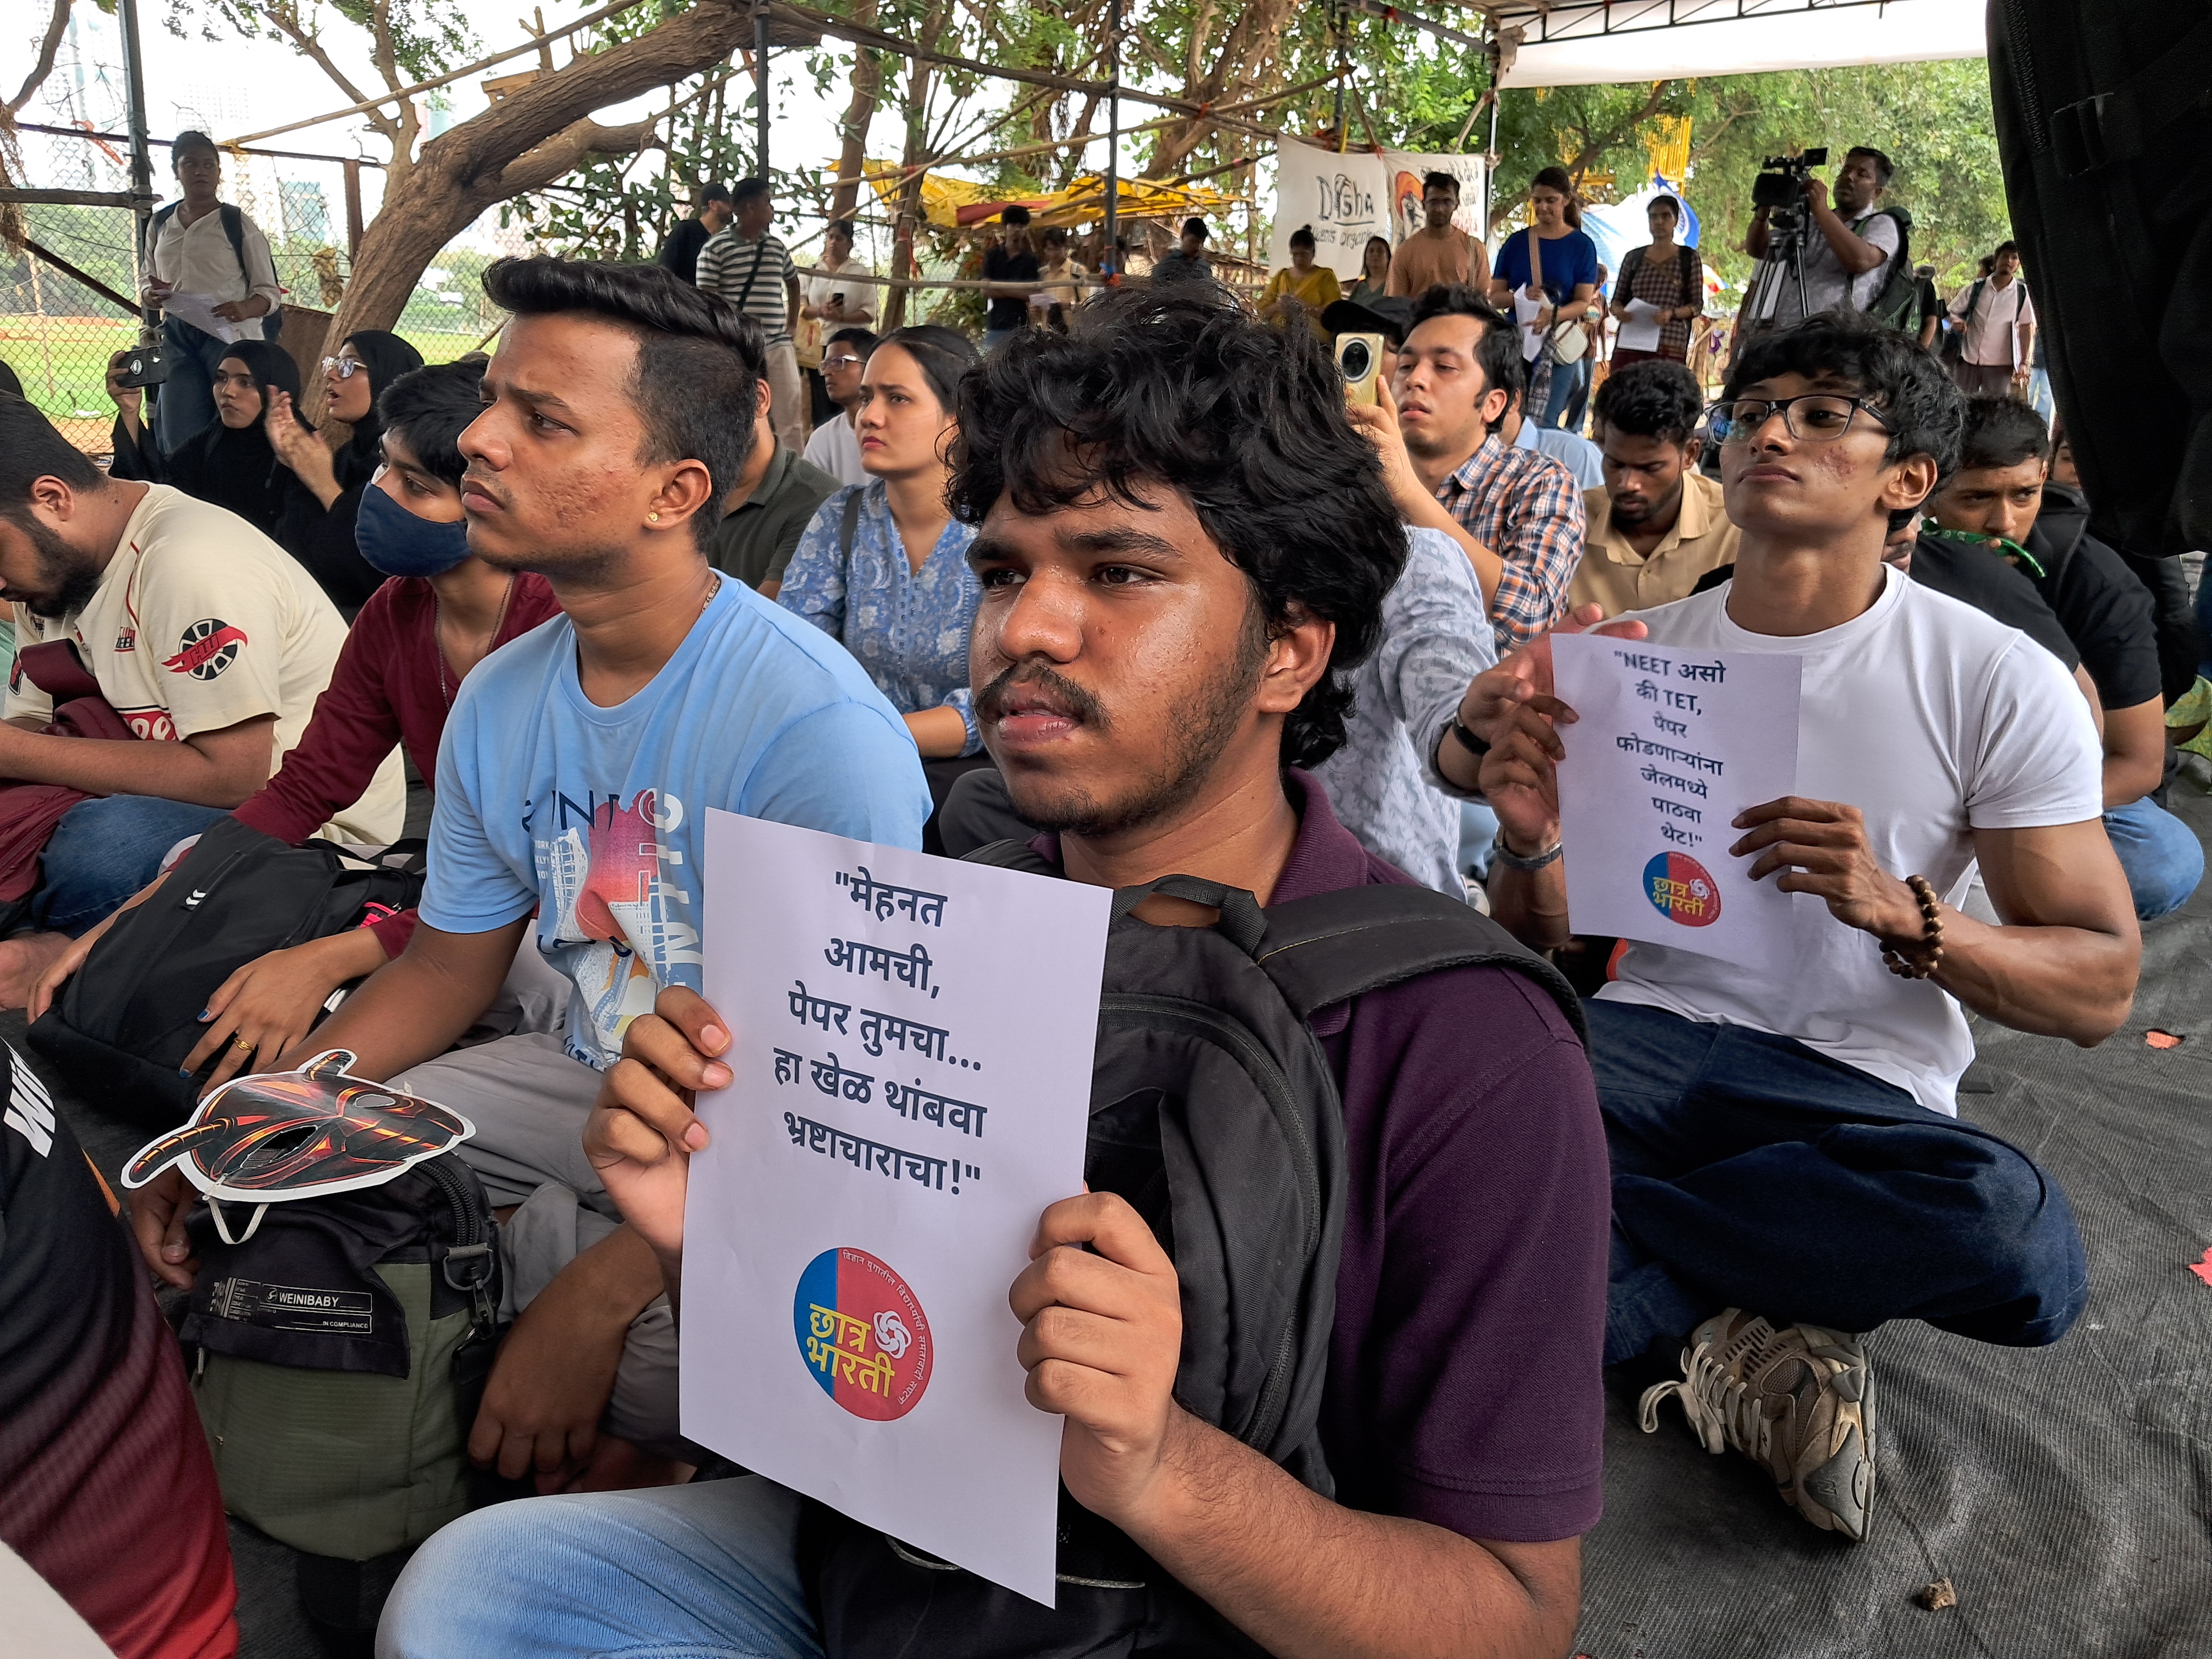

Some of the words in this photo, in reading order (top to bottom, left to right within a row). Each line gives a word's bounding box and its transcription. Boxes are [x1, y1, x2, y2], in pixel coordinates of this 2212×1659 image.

[1615, 650, 1672, 677] "NEET
[1677, 660, 1727, 684] असो
[1635, 679, 1658, 702] की
[1663, 689, 1702, 716] TET,
[1652, 710, 1688, 738] पेपर
[1639, 763, 1708, 800] जेलमध्ये
[1650, 796, 1702, 824] पाठवा
[1660, 821, 1703, 847] थेट!"
[835, 866, 948, 927] "मेहनत
[1652, 877, 1689, 898] छात्र
[1652, 891, 1704, 916] भारती
[824, 938, 940, 999] आमची,
[788, 980, 852, 1036] पेपर
[860, 1008, 981, 1071] तुमचा...
[773, 1047, 803, 1086] हा
[810, 1052, 875, 1104] खेळ
[884, 1077, 988, 1138] थांबवा
[783, 1111, 980, 1195] भ्रष्टाचाराचा!"
[843, 1249, 865, 1265] विज्ञान
[867, 1260, 896, 1286] युगातील
[279, 1291, 339, 1307] WEINIBABY
[809, 1303, 872, 1352] छात्र
[806, 1336, 895, 1398] भारती
[914, 1335, 927, 1380] समतावादी
[897, 1381, 918, 1405] संघटना
